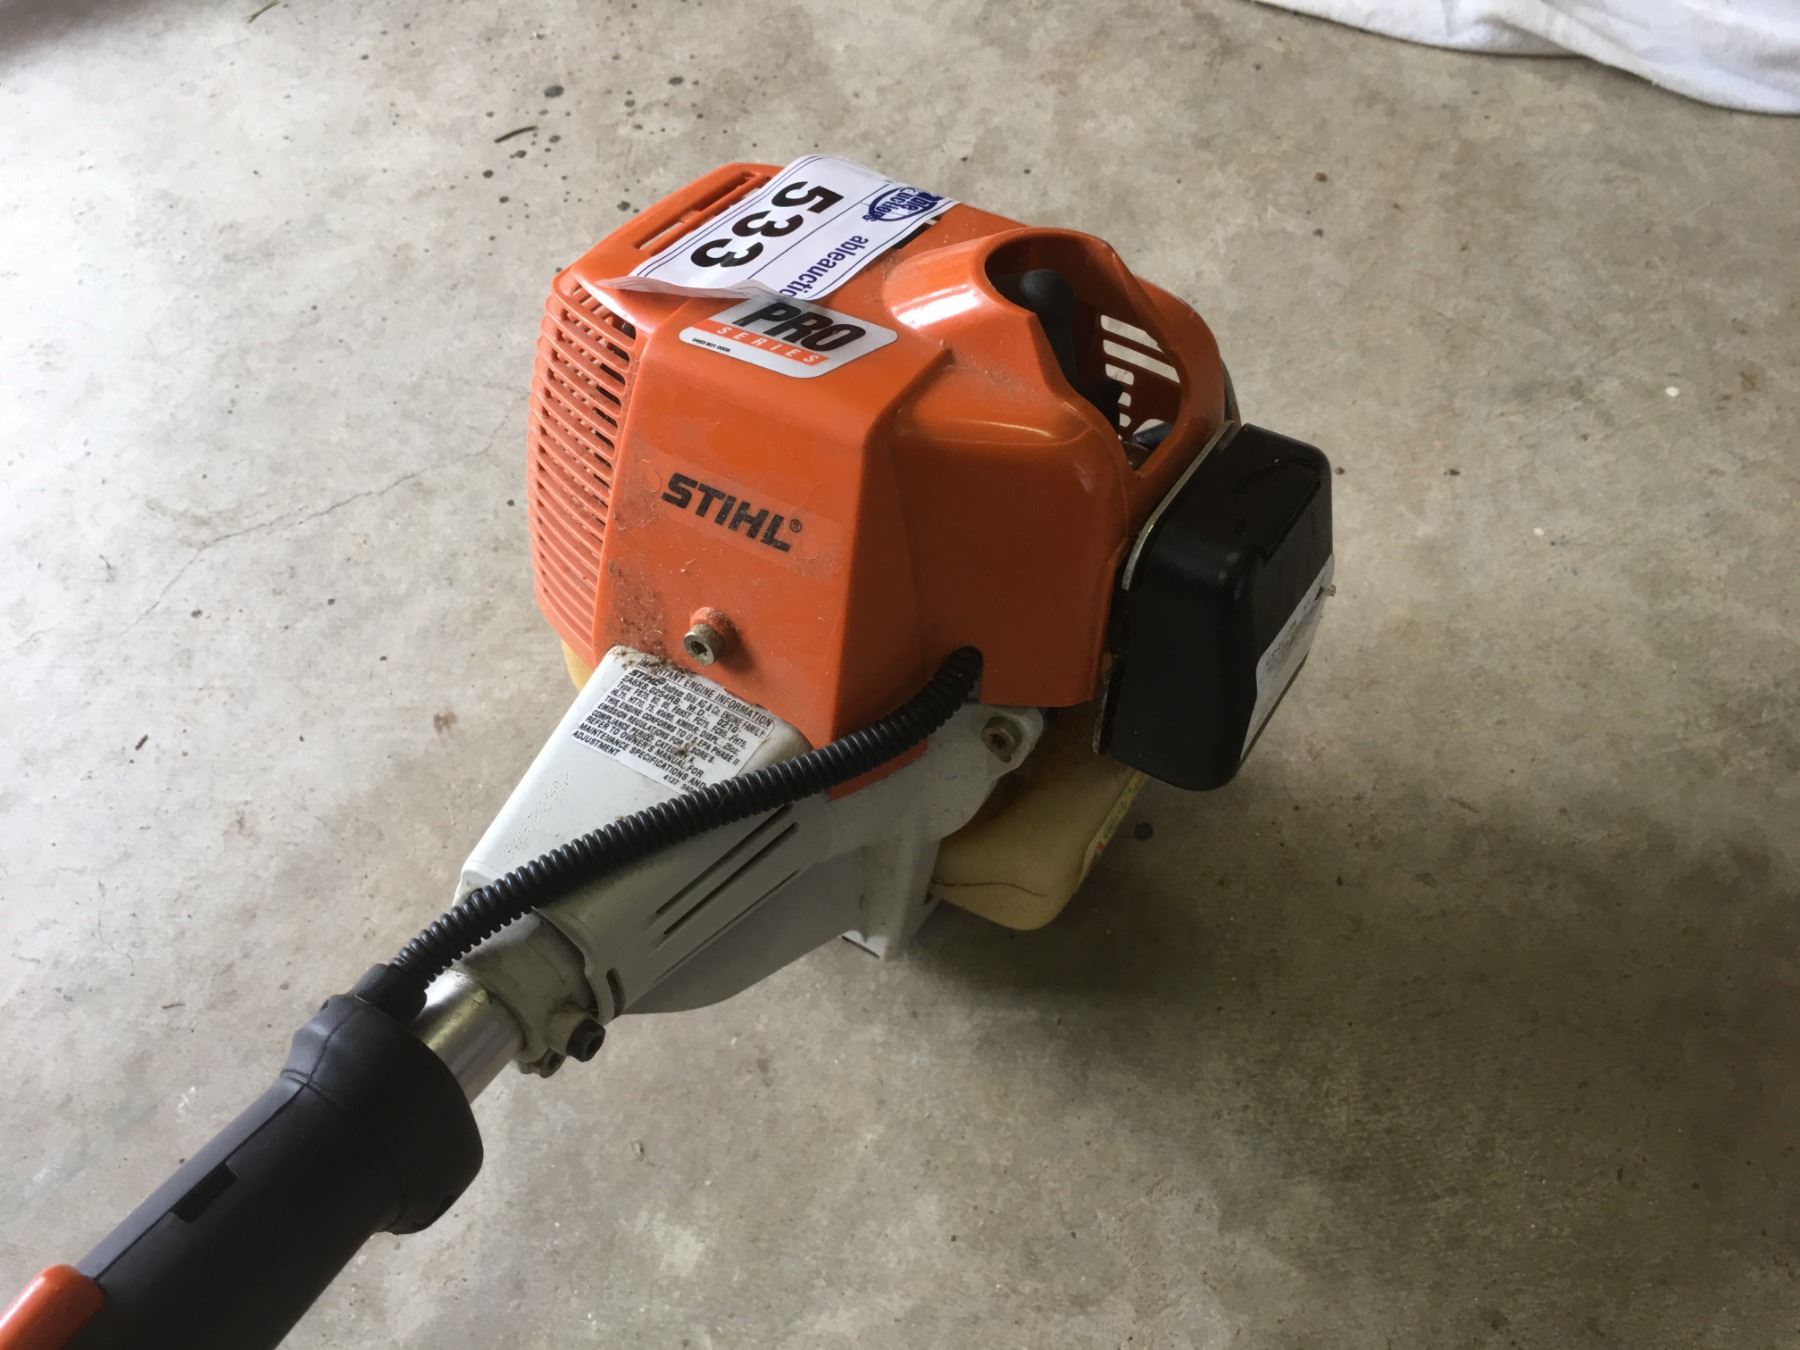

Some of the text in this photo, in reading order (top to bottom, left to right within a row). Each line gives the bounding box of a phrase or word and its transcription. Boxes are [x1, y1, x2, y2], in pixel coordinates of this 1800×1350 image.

[690, 181, 844, 268] 533
[716, 326, 822, 363] SERIES
[733, 302, 866, 351] PRO
[637, 658, 774, 726] IMRTANT ENGINE INFORMATION
[572, 728, 620, 756] ADJUSTMENT
[591, 708, 631, 731] COMPLIANCE
[598, 702, 628, 719] EMISSION
[627, 715, 670, 739] REGULATIONS
[669, 736, 684, 746] FOR
[605, 695, 620, 705] THIS
[619, 701, 643, 715] ENGINE
[642, 712, 676, 731] CONFORMS
[697, 739, 712, 749] EPA
[710, 746, 734, 761] PHASE
[721, 711, 744, 725] ENGINE
[579, 721, 707, 789] MAINTENANCE SPECIFICATIONS AND
[586, 715, 704, 777] REFER TO OWNER'S MANUAL FOR
